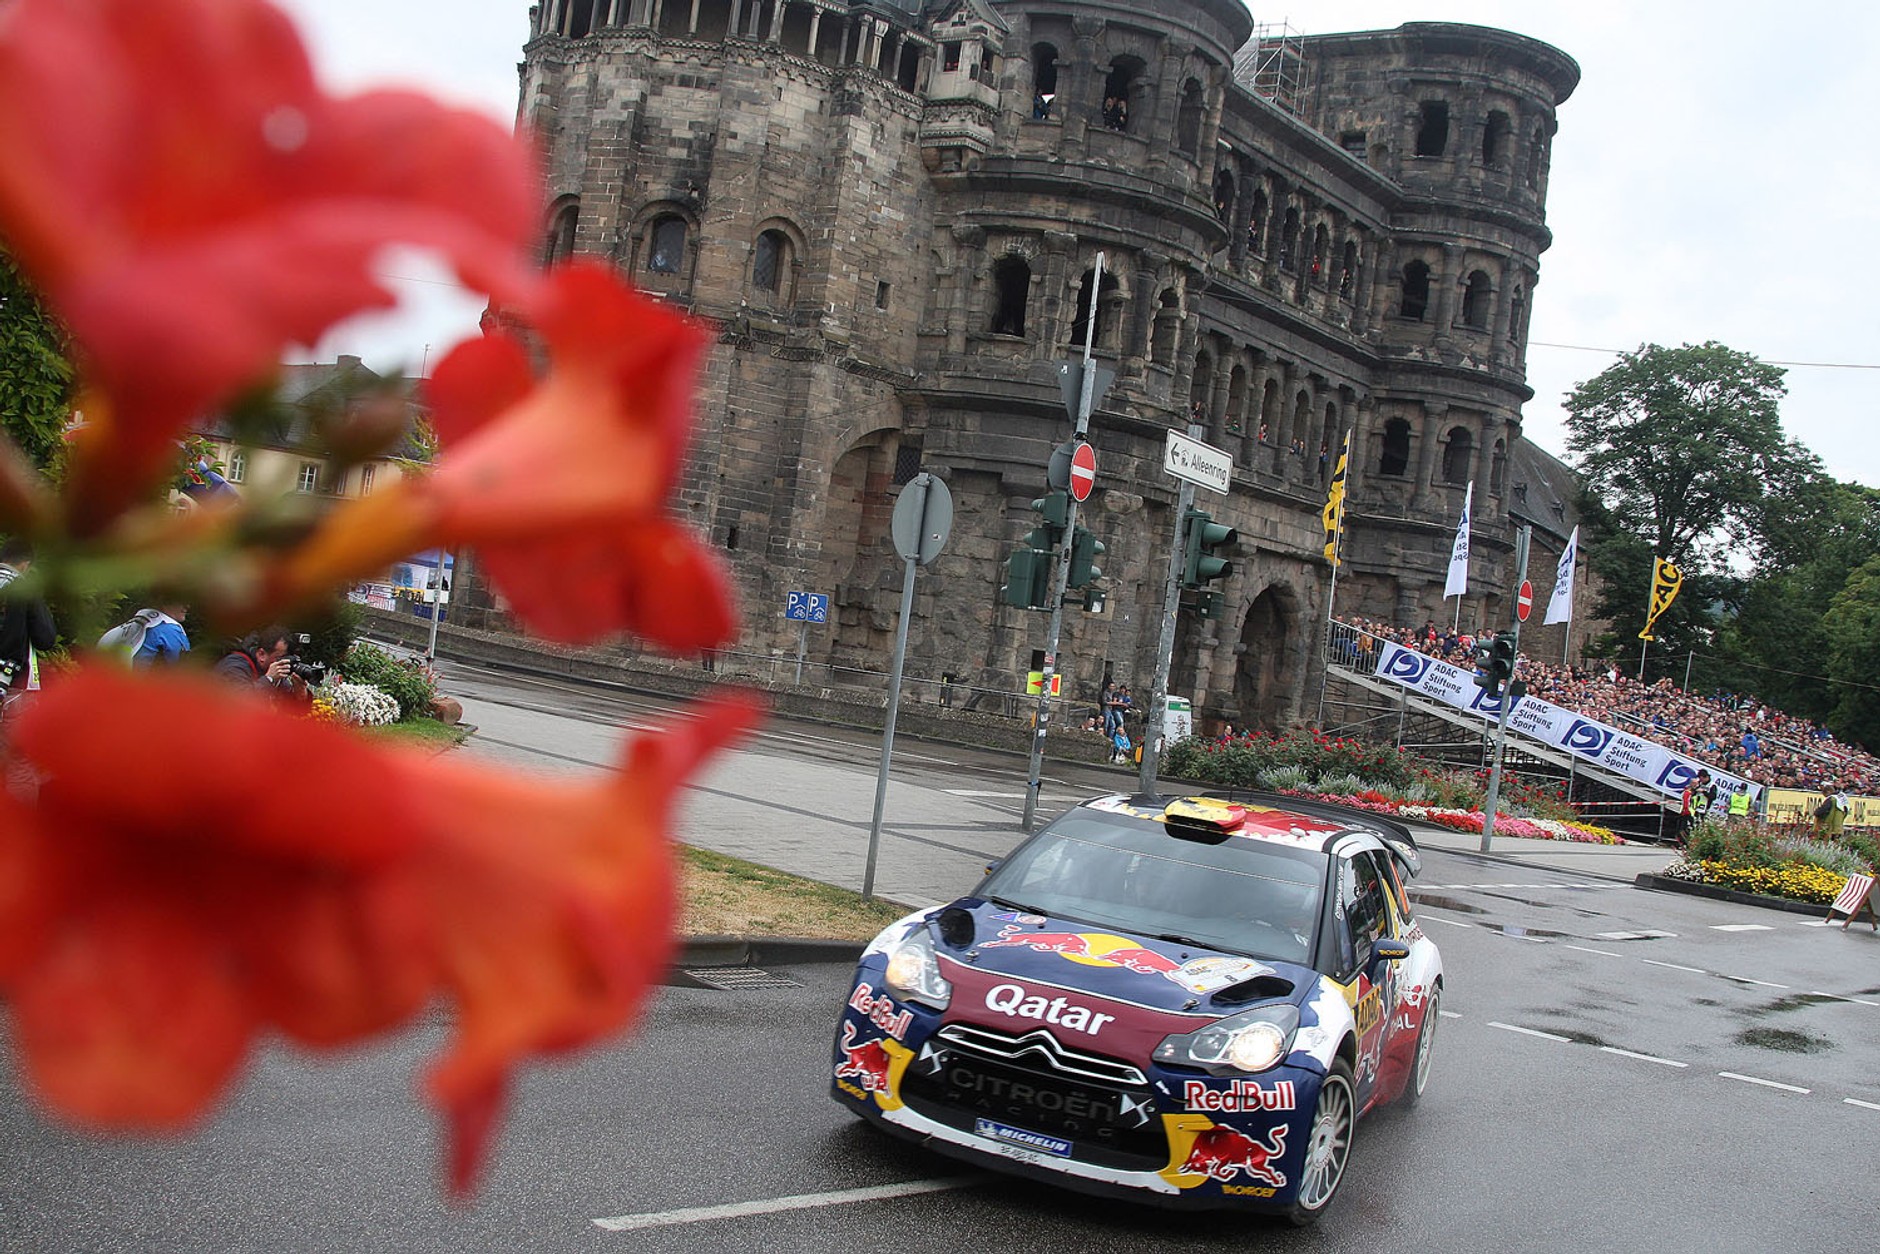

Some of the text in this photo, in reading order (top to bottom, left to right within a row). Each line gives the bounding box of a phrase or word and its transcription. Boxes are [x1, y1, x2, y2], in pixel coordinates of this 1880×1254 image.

[1191, 454, 1226, 485] Alleenring
[1434, 663, 1458, 679] ADAC
[1423, 681, 1446, 697] Sport
[1428, 673, 1462, 694] Stiftung
[1523, 700, 1549, 714] ADAC
[1511, 717, 1537, 733] Sport
[1517, 709, 1553, 729] Stiftung
[1617, 737, 1642, 752] ADAC
[1604, 755, 1630, 771] Sport
[1610, 747, 1647, 768] Stiftung
[985, 983, 1116, 1036] Qatar
[998, 1128, 1068, 1152] MICHELIN
